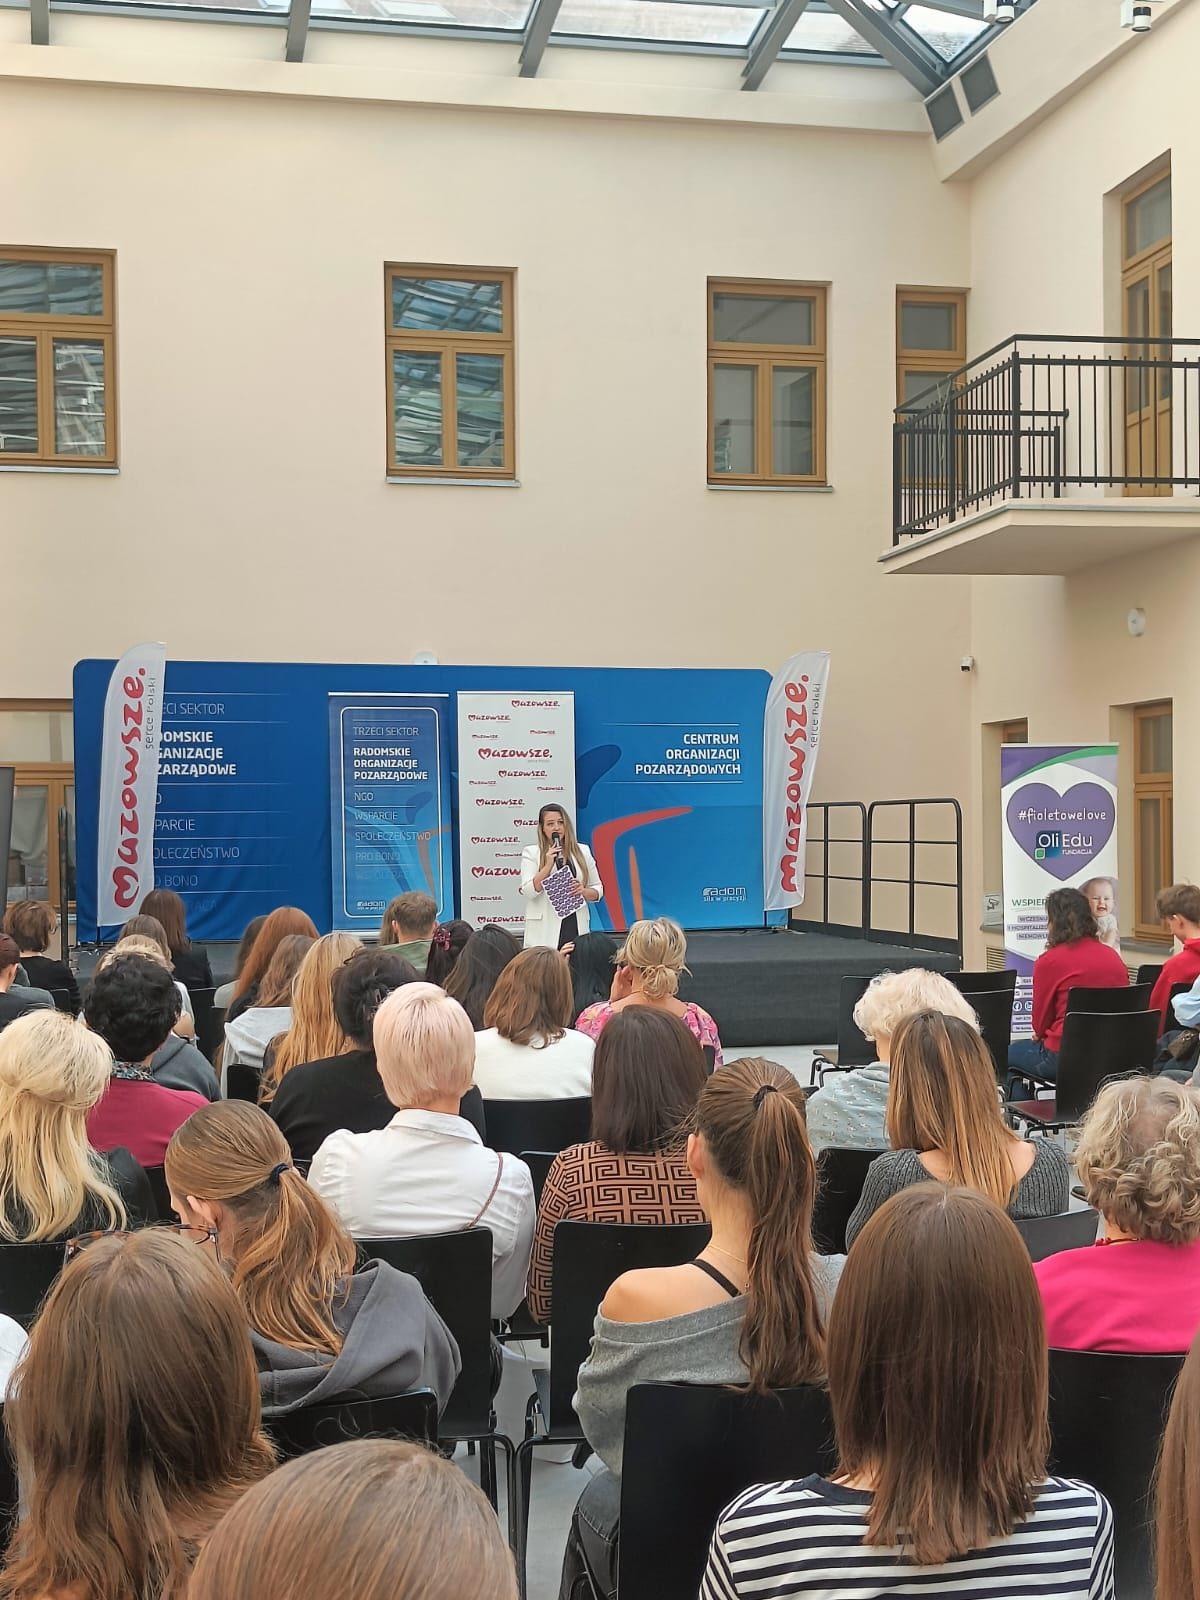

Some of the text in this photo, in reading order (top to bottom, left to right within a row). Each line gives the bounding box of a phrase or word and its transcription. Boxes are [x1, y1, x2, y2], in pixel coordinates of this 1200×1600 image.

[162, 703, 225, 715] ECI SEKTOR
[353, 727, 420, 736] TRZECI SEKTOR
[683, 733, 739, 745] CENTRUM
[157, 747, 224, 761] GANIZACJE
[353, 747, 411, 756] RADOMSKIE
[477, 748, 553, 760] Mazowsze.
[665, 748, 740, 761] ORGANIZACJI
[353, 759, 418, 769] ORGANIZACJE
[635, 763, 741, 777] POZARZĄDOWYCH
[157, 763, 237, 778] ZARZĄDOWE
[354, 771, 429, 781] POZARZĄDOWE
[354, 792, 374, 801] NGO
[355, 811, 398, 820] WSPARCIE
[1017, 807, 1107, 824] #fioletowelove
[155, 818, 196, 831] PARCIE
[513, 819, 539, 828] Mazo
[471, 866, 522, 878] Mazow
